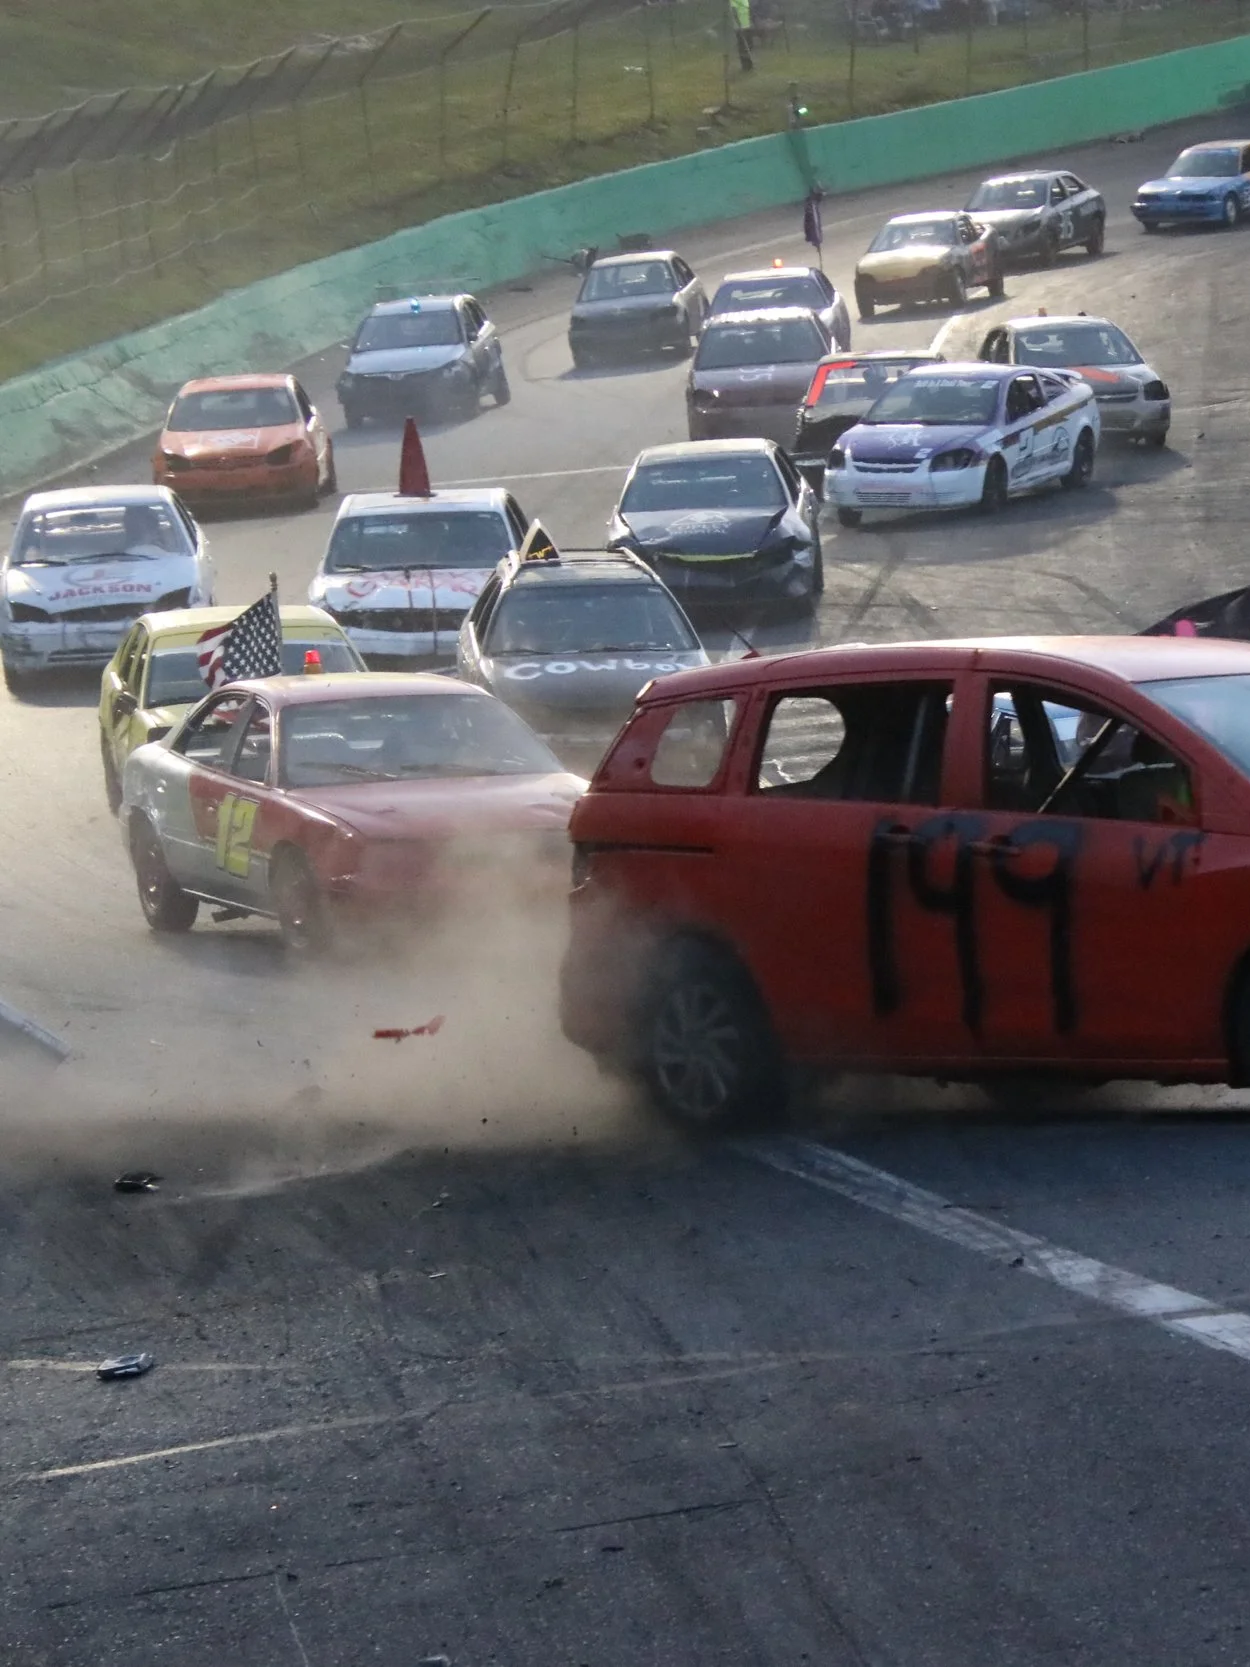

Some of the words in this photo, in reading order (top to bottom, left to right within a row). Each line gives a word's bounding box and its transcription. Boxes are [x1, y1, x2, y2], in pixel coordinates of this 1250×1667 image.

[48, 583, 152, 601] JACKSON
[215, 791, 260, 878] 12
[868, 812, 1085, 1040] 199
